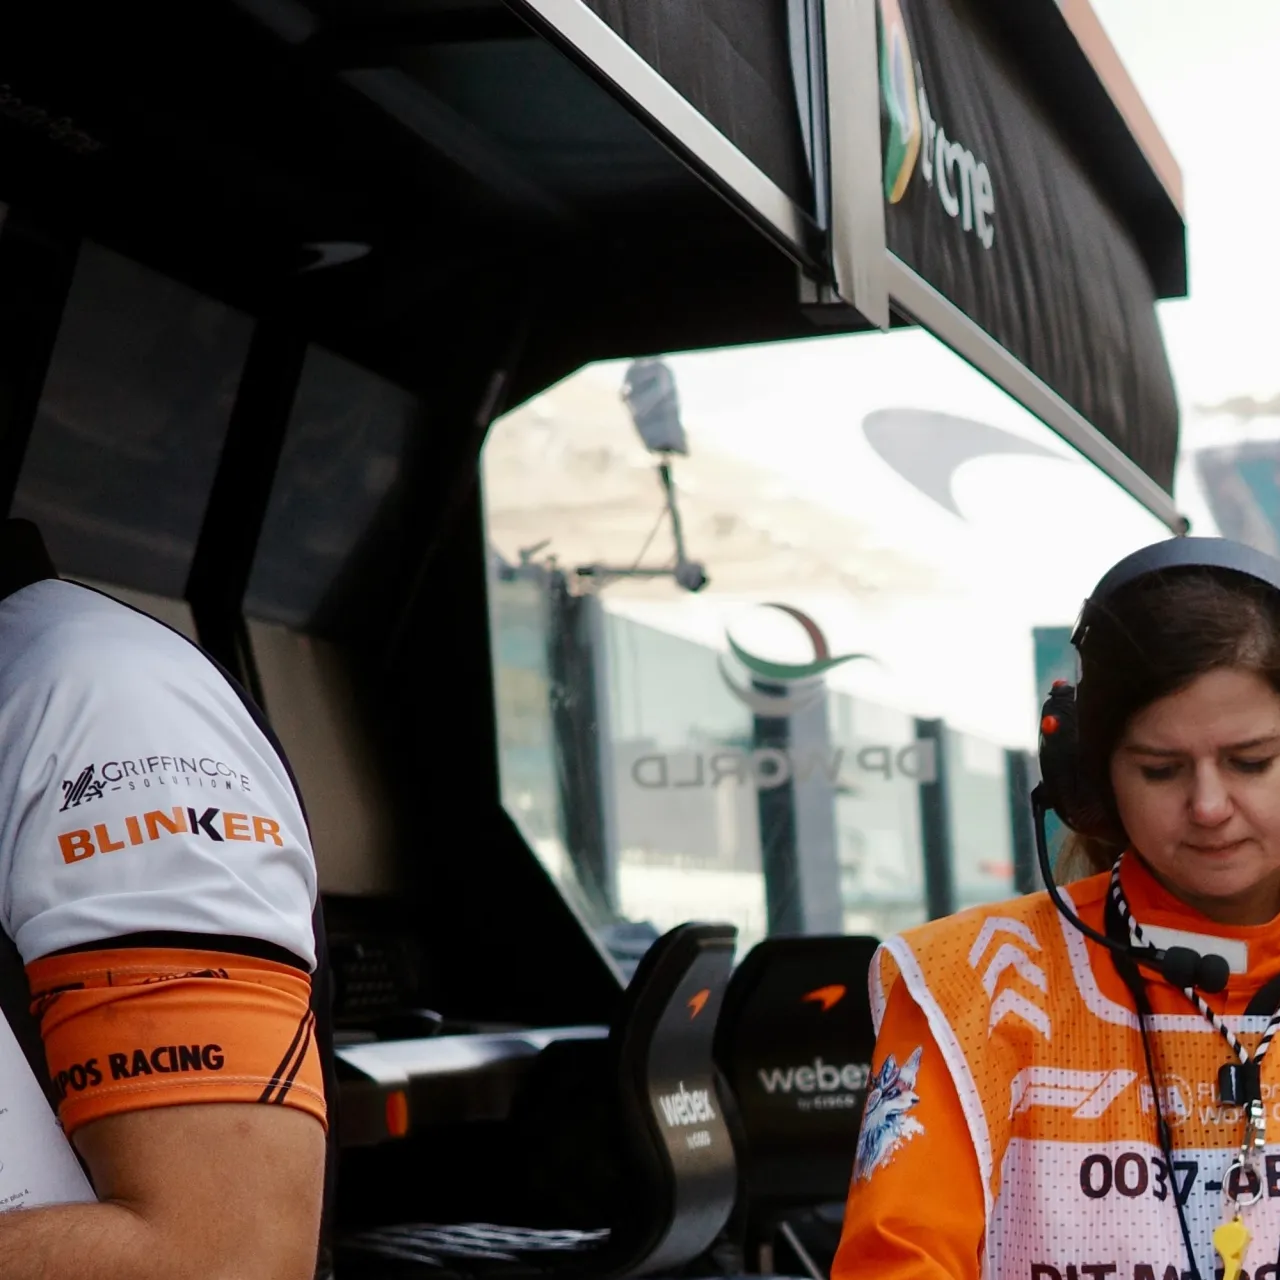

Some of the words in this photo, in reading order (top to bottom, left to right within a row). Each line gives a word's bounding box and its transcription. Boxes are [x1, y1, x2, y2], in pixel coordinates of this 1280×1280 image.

[129, 776, 236, 791] SOLUTION
[58, 806, 284, 865] BLINKER
[109, 1044, 225, 1081] RACING
[660, 1080, 717, 1128] webex
